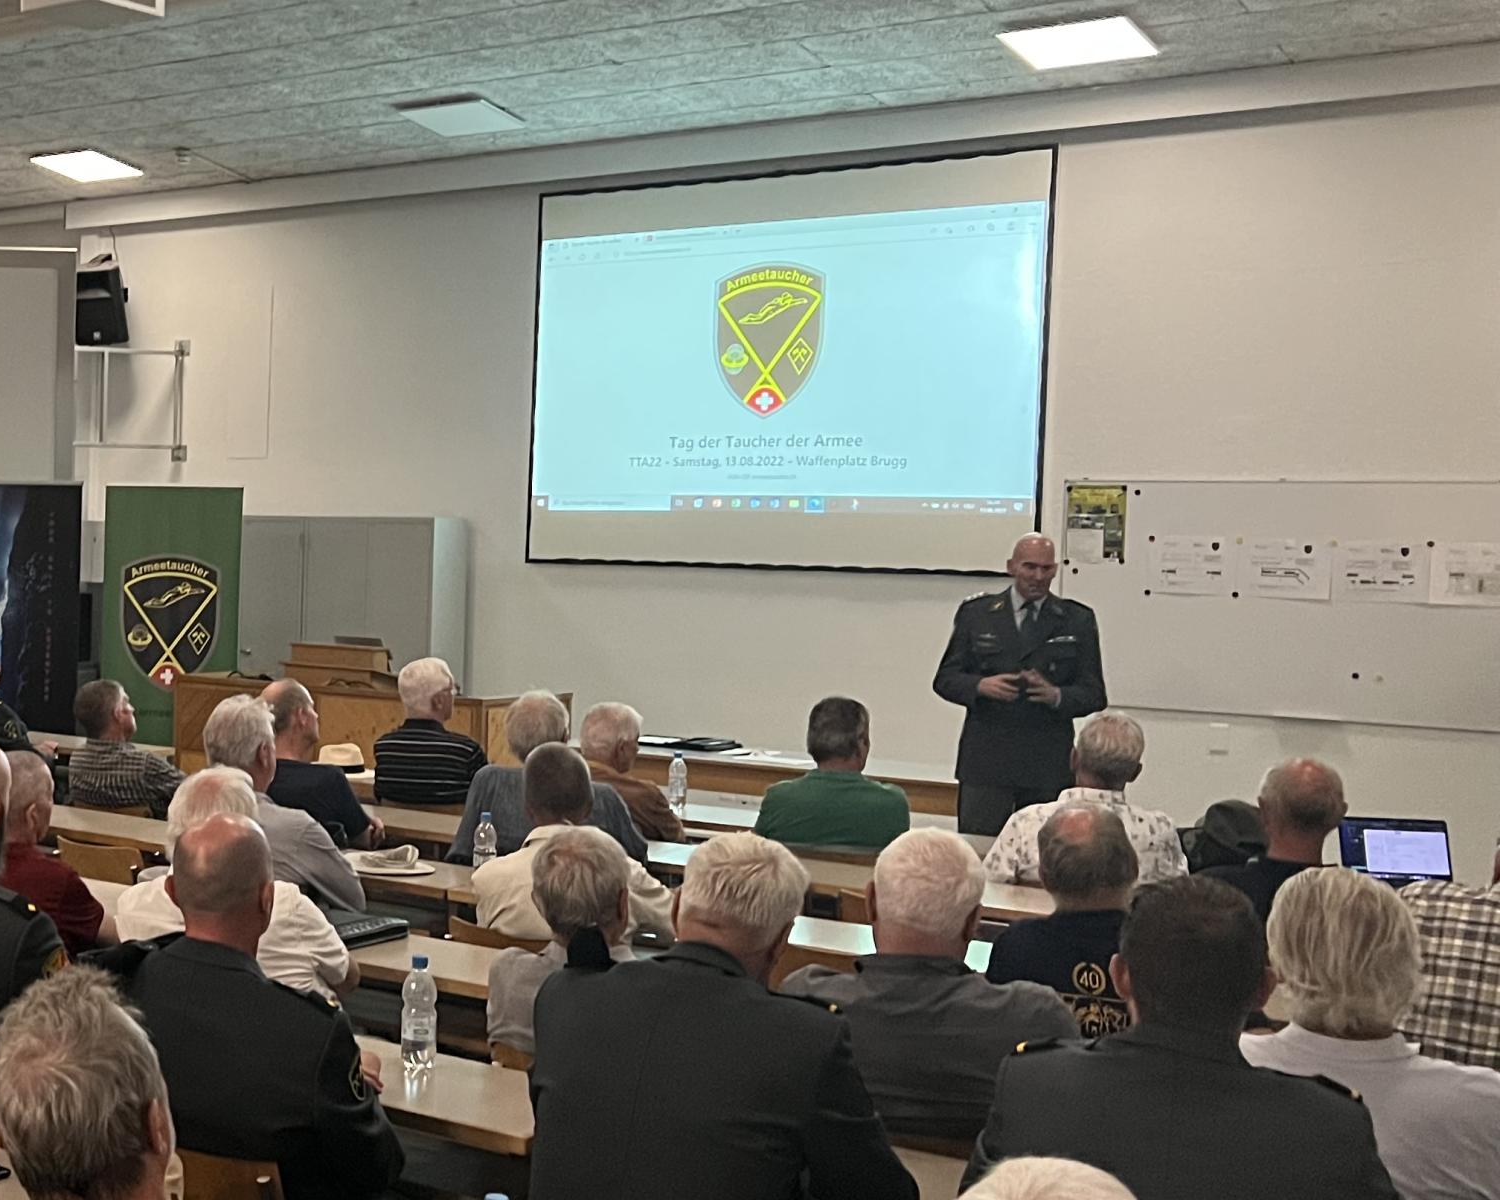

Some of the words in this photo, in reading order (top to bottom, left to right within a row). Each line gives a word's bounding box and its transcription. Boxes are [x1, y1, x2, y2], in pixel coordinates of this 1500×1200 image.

[726, 269, 813, 291] Armeetaucher
[669, 436, 694, 452] Tag
[698, 435, 721, 448] der
[726, 435, 781, 448] Taucher
[786, 434, 809, 447] der
[814, 434, 863, 447] Armee
[629, 457, 662, 467] TTA22
[725, 455, 784, 467] 13.08.2022
[796, 455, 867, 468] Waffenplatz
[870, 455, 907, 469] Brugg
[131, 560, 210, 578] Armeetaucher
[1079, 970, 1100, 989] 40
